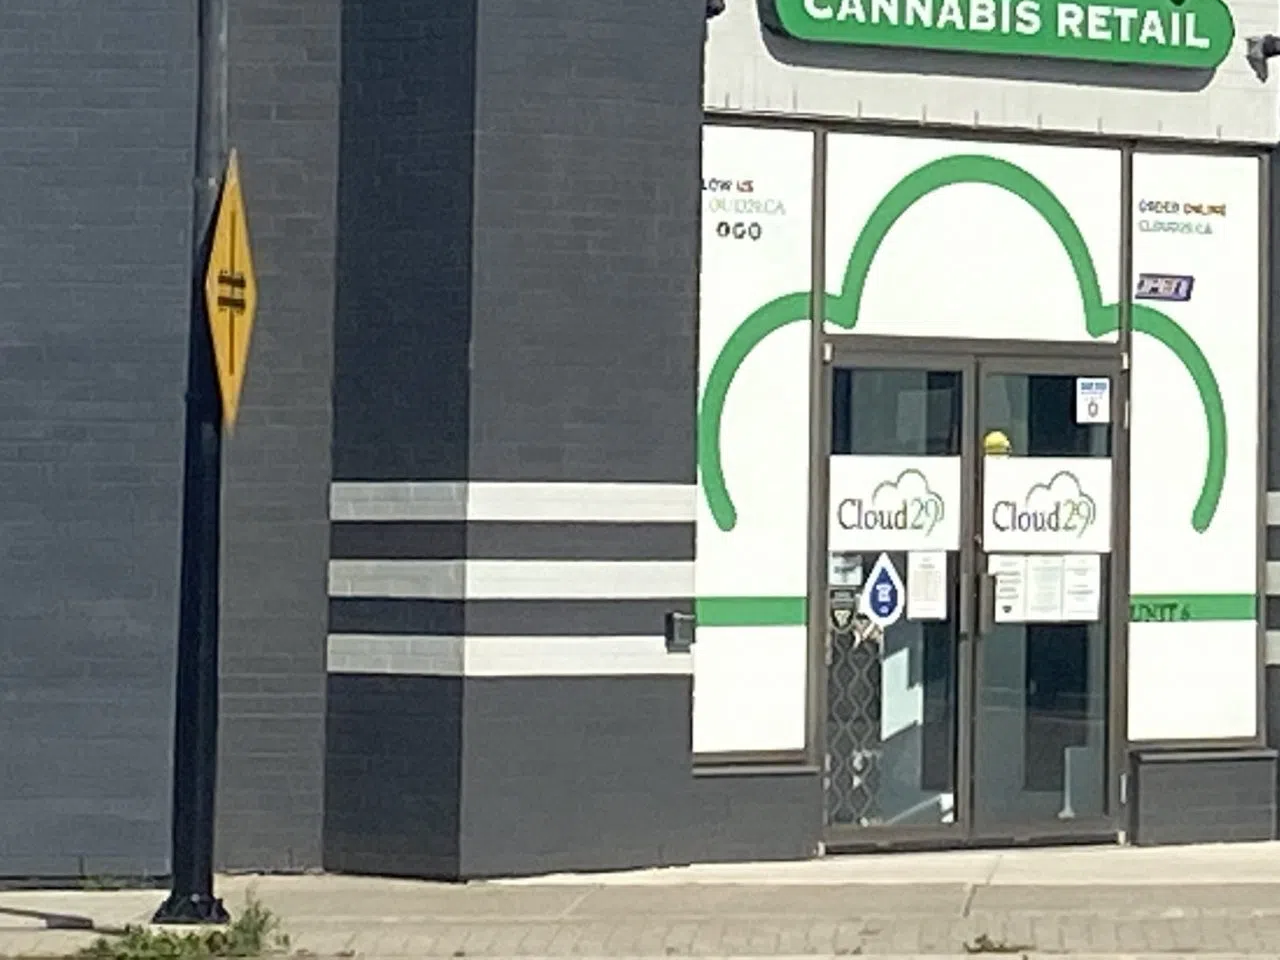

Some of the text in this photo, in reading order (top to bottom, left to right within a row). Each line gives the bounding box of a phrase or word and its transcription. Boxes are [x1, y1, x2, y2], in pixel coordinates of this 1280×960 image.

[1056, 6, 1211, 49] RETAIL
[837, 497, 940, 537] Cloud29
[992, 499, 1091, 538] Cloud29
